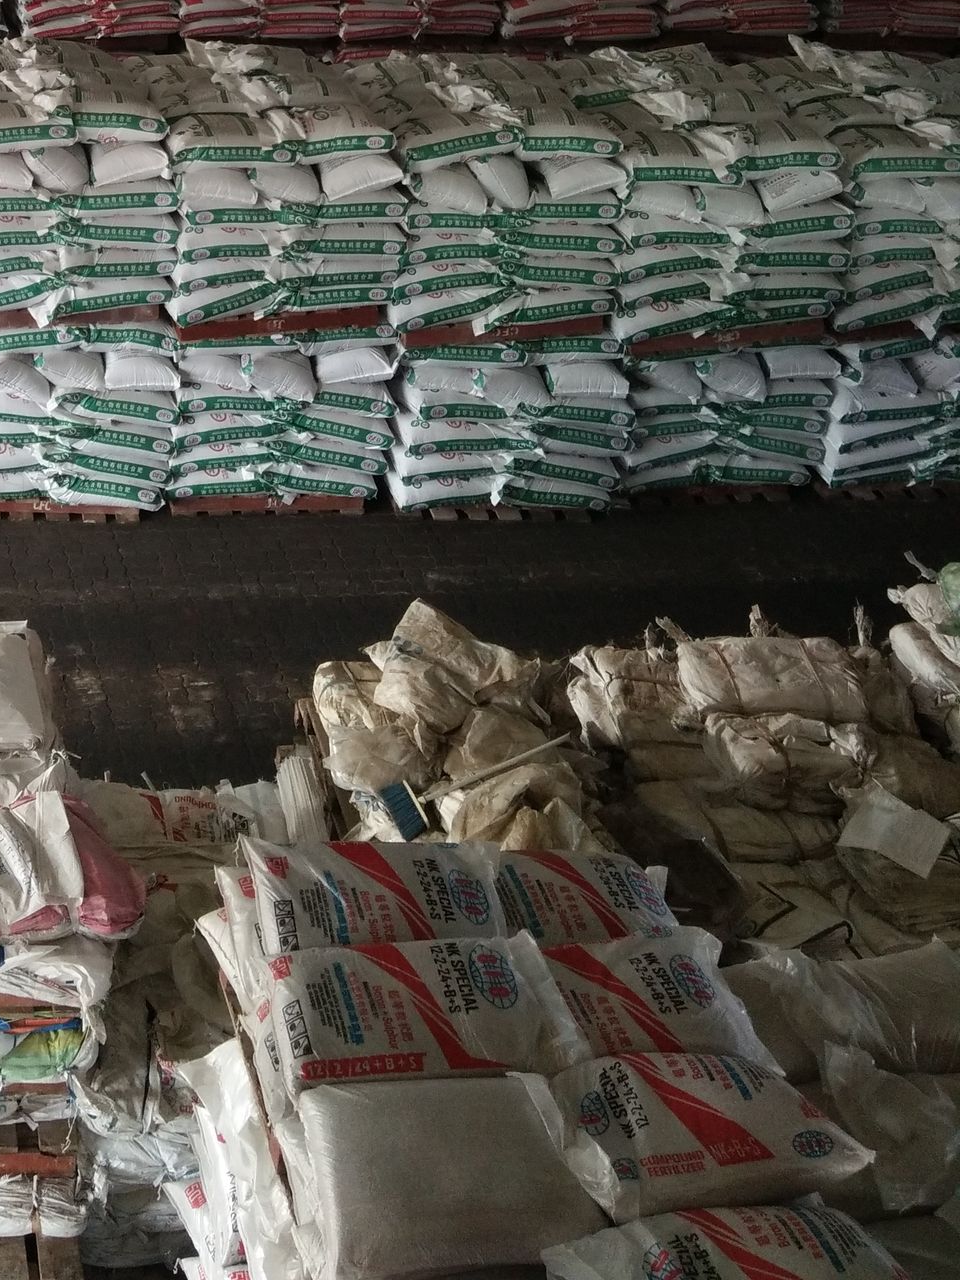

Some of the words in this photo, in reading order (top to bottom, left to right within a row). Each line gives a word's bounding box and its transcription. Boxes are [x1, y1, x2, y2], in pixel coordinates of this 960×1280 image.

[432, 875, 457, 923] SPECIAL
[611, 870, 640, 912] SPECIAL
[443, 941, 460, 958] NK
[428, 944, 463, 1015] 12-2-24+B+S
[450, 959, 481, 1015] SPECIAL
[653, 966, 689, 1016] SPECIAL
[640, 1150, 706, 1167] COMPOUND
[647, 1162, 706, 1178] FERTILIZER
